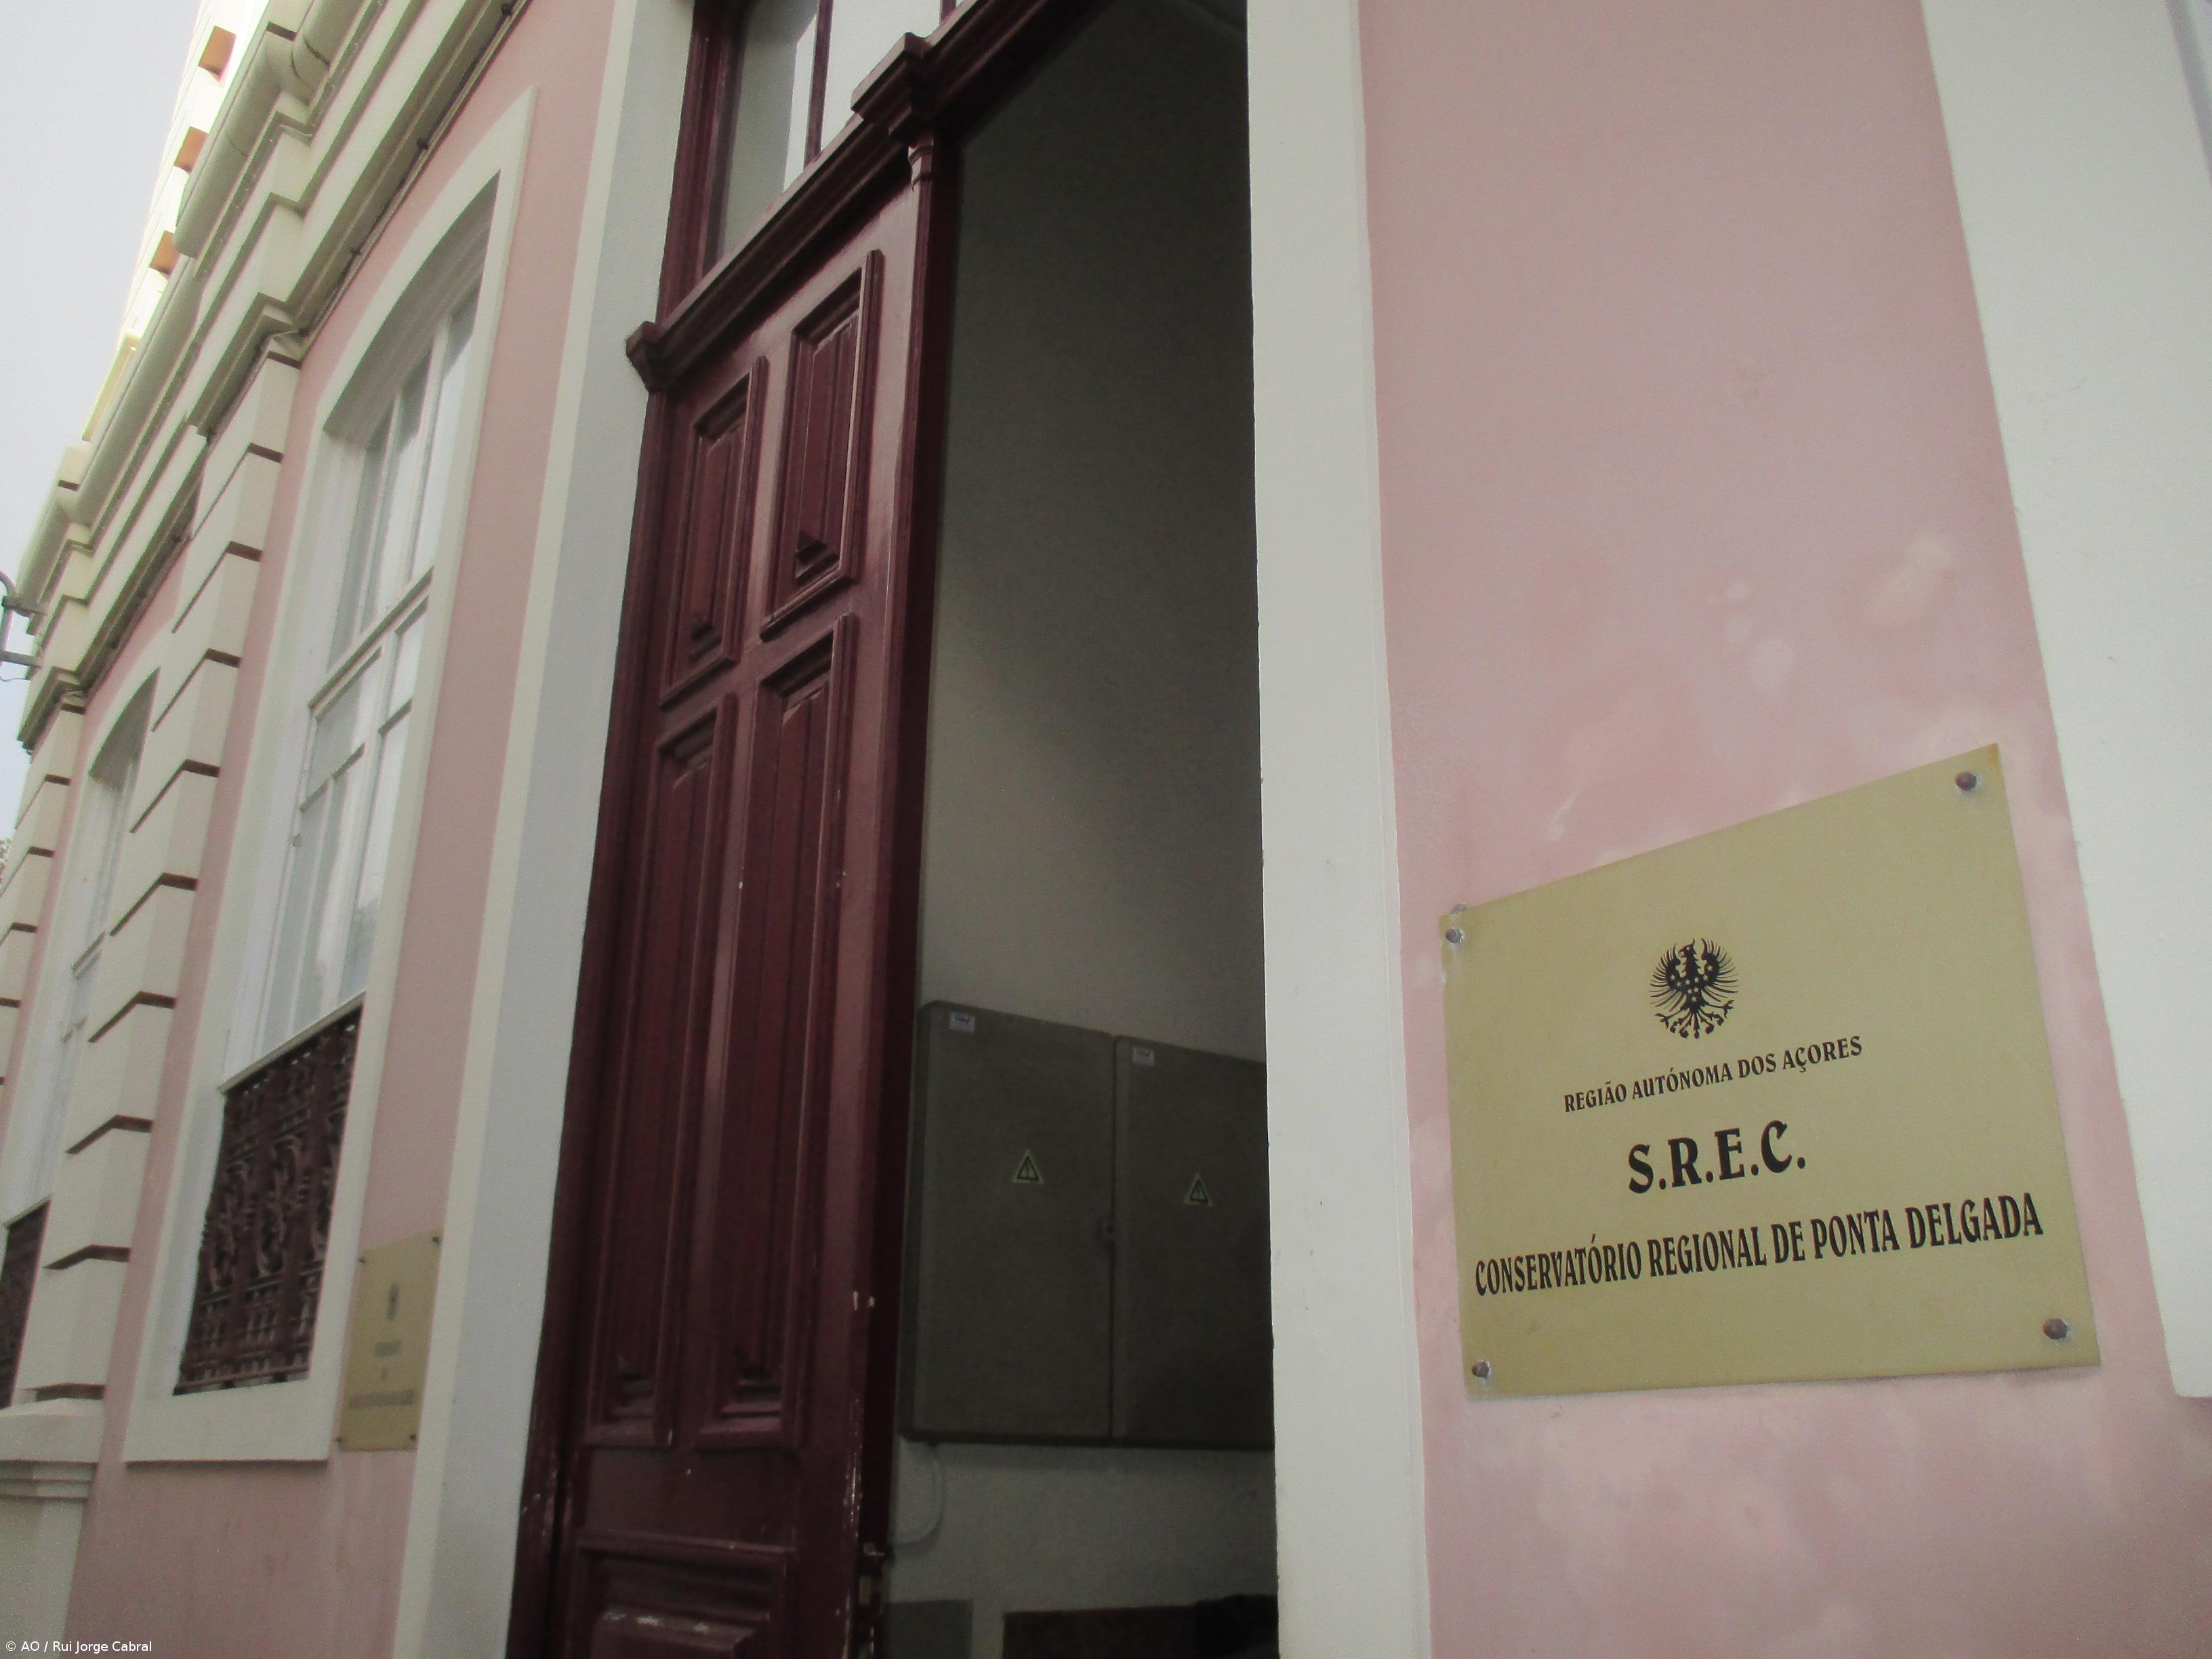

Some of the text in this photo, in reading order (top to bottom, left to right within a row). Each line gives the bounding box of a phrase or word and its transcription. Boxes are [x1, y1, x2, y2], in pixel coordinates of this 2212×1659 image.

[1563, 1035, 1862, 1113] REGIÃO AUTÓNOMA DOS AÇORES
[1628, 1120, 1806, 1195] S.R.E.C.
[1475, 1192, 2044, 1296] CONSERVATÓRIO REGIONAL DE PONTA DELGADA
